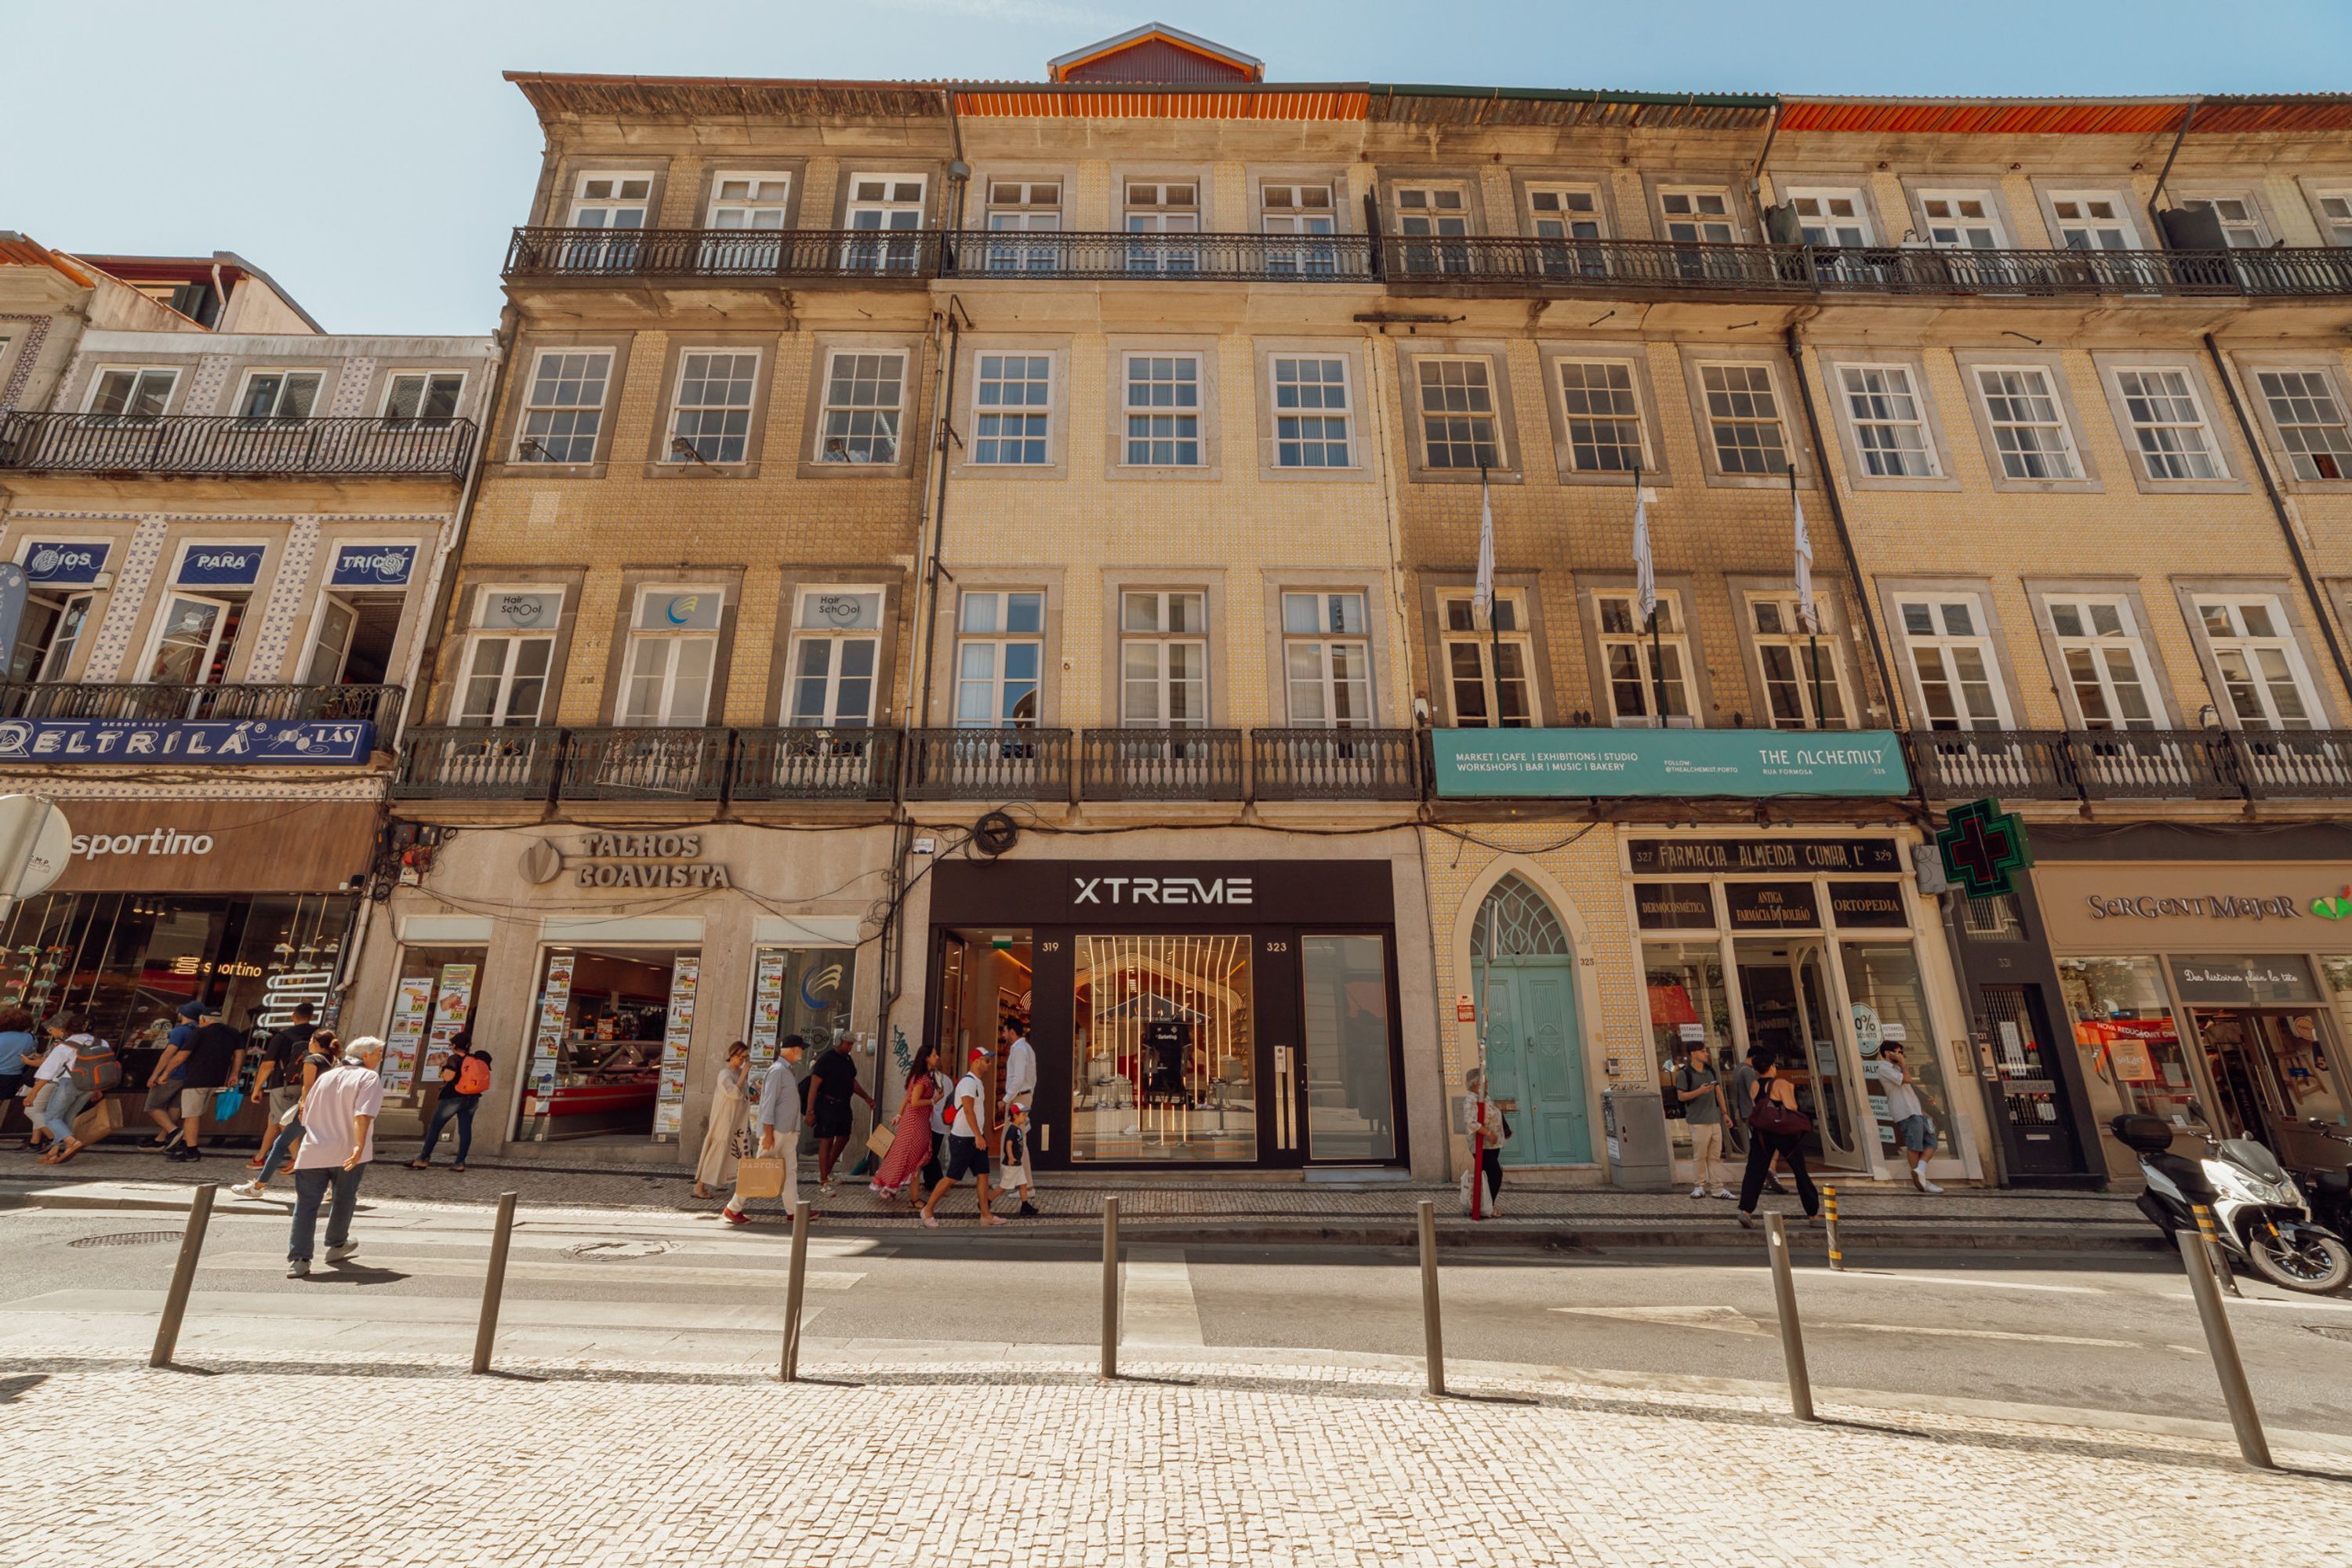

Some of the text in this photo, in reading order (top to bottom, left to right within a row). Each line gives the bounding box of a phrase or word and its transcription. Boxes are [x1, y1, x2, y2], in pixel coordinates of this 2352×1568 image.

[197, 554, 246, 568] PARA
[315, 726, 355, 742] LÃS
[1456, 753, 1638, 761] MARKET CAFE EXHIBITIONS STUDIO
[1759, 750, 1790, 764] THE
[1457, 763, 1624, 771] WORKSHOPS BAR MUSIC BAKERY
[71, 828, 213, 859] sportino
[579, 834, 702, 858] TALHOS
[1637, 851, 1653, 862] 327
[1659, 845, 1727, 866] FARMACIA
[1739, 845, 1797, 866] ALMEIDA
[1874, 850, 1893, 861] 329
[575, 864, 731, 887] BOAVISTA
[1073, 877, 1253, 904] XTREME
[1758, 891, 1783, 903] ANTIGA
[1642, 900, 1706, 913] DERMOCOSMÉTICA
[1834, 899, 1899, 912] ORTOPEDIA
[1737, 906, 1769, 921] FARMÁCIA
[1781, 906, 1810, 921] BOLHÃO
[1042, 942, 1059, 952] 319
[1266, 942, 1287, 953] 323
[2184, 969, 2204, 982] Des
[2205, 969, 2242, 982] histoires
[2245, 969, 2267, 988] plein
[2267, 969, 2280, 982] la
[2096, 1022, 2116, 1032] NOVA
